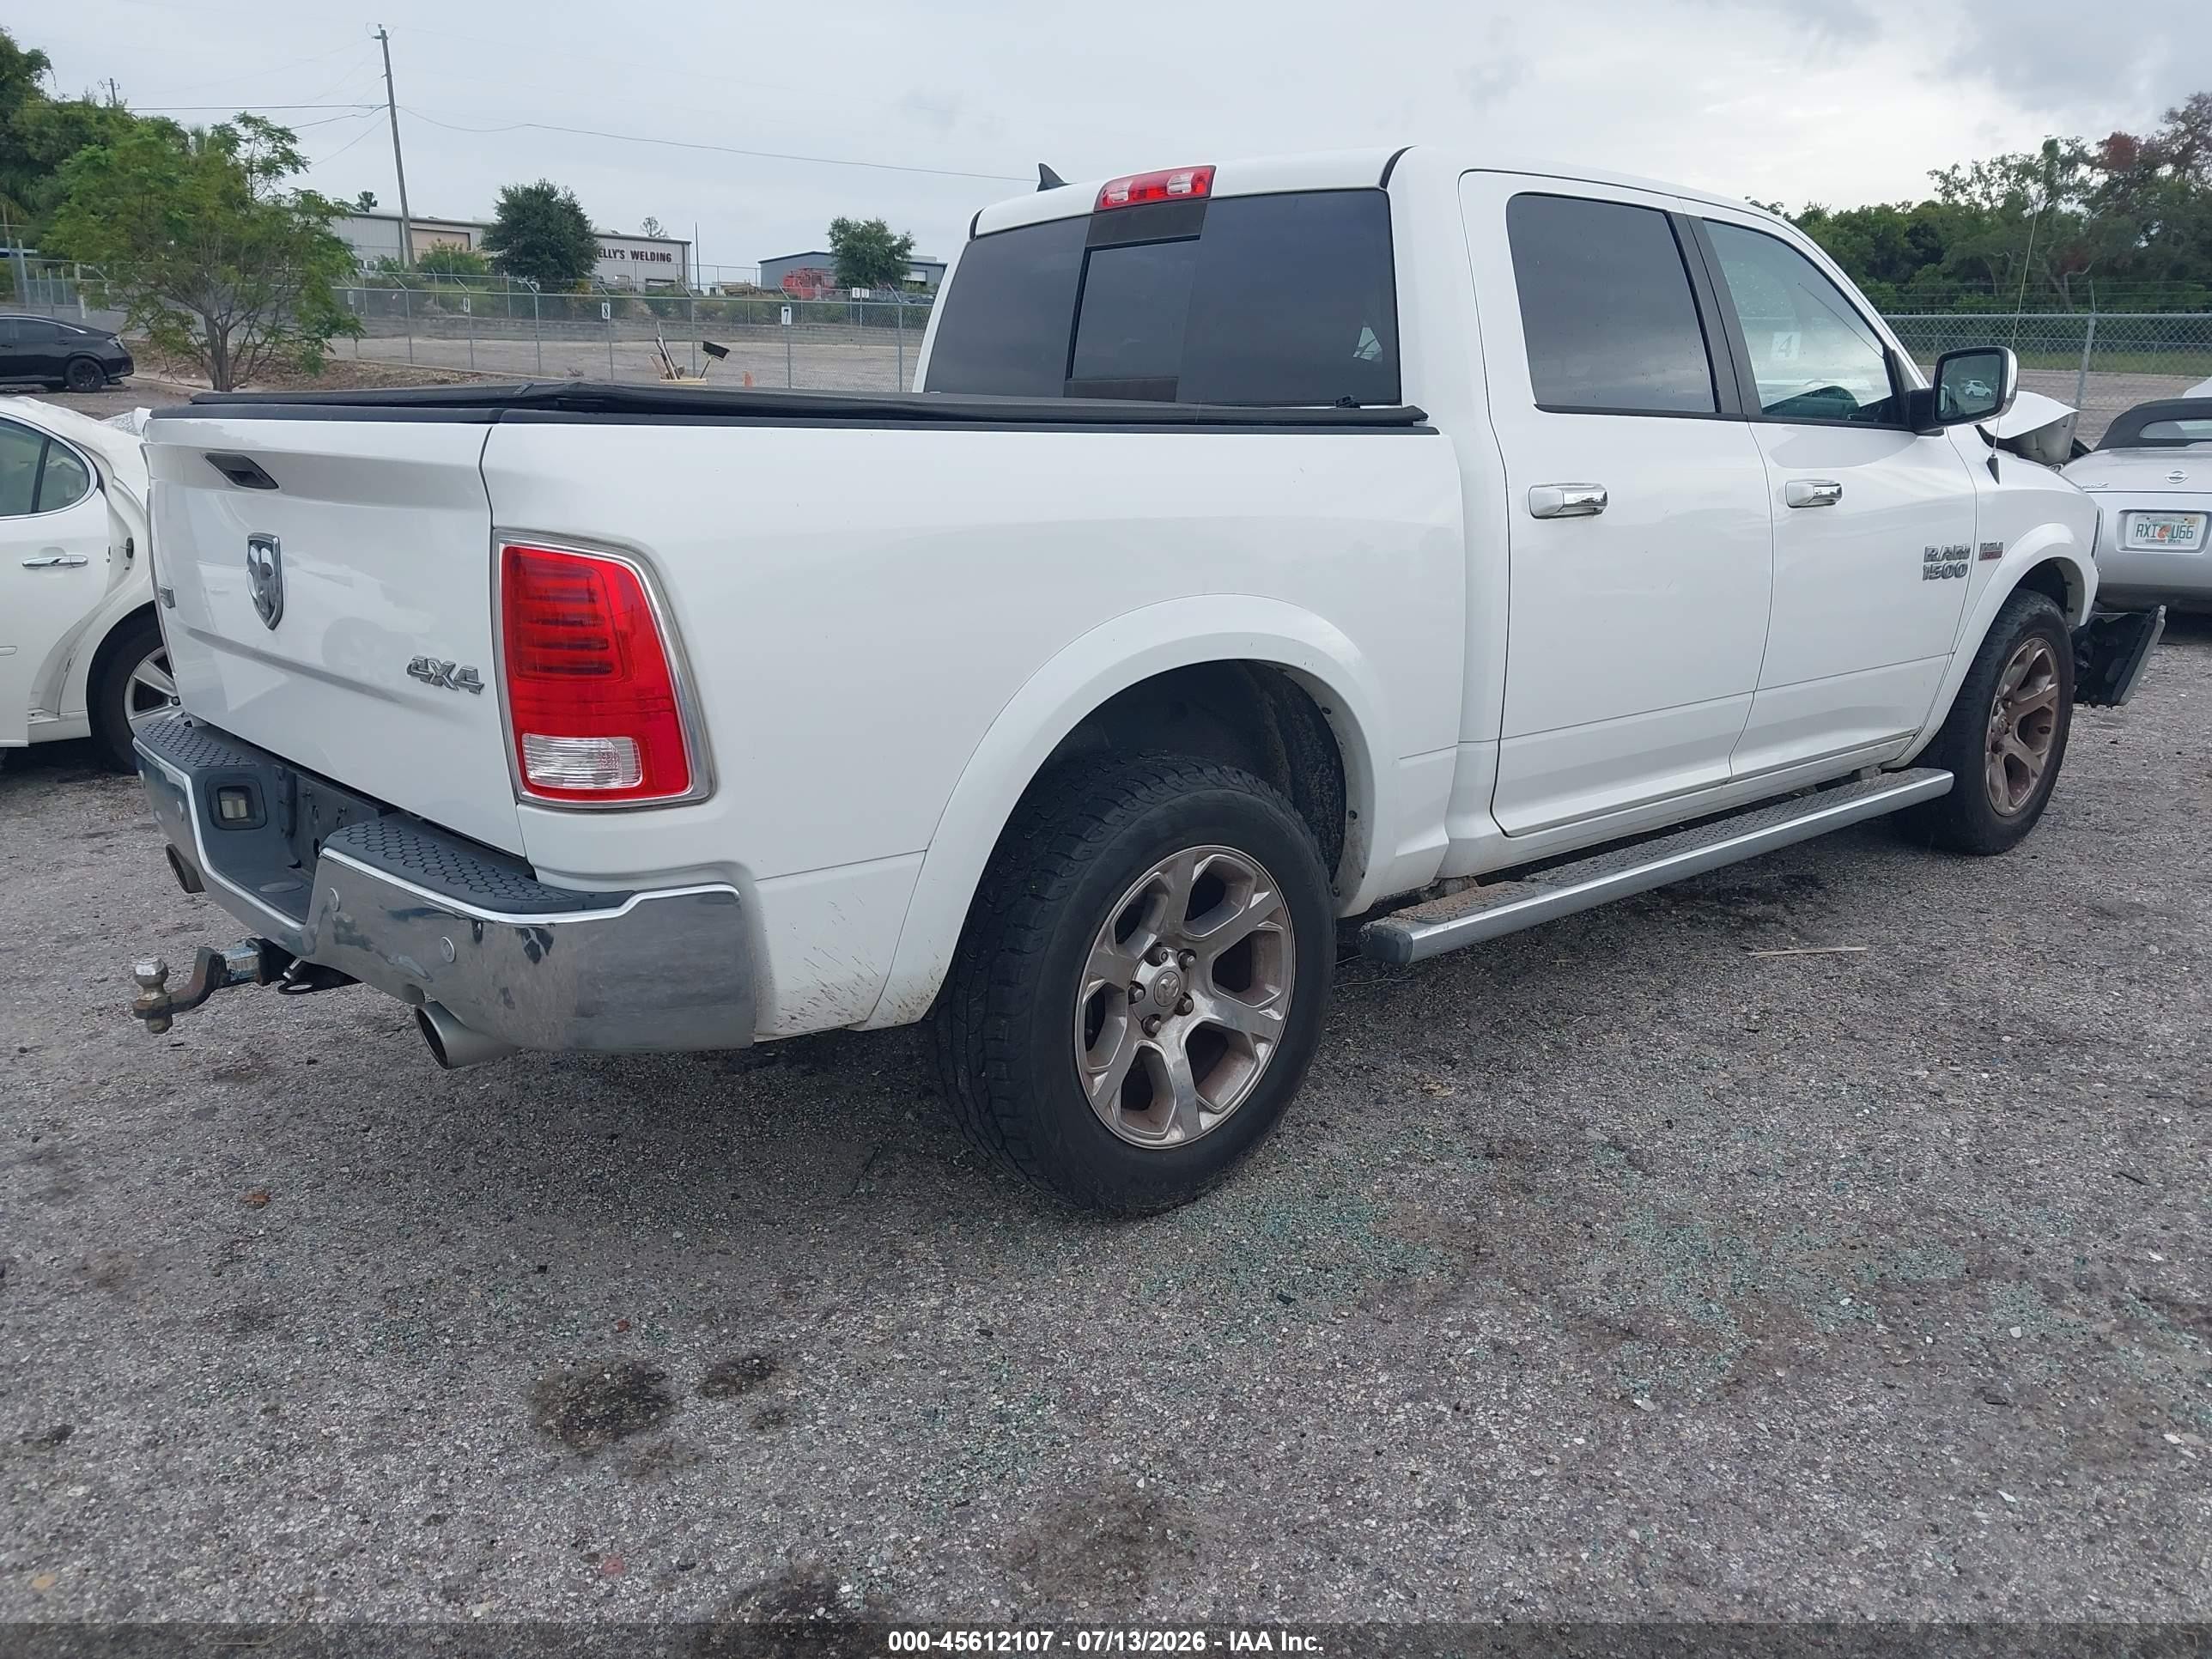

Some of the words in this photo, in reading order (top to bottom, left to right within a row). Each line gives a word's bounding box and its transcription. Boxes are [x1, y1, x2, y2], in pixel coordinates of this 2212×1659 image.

[595, 247, 626, 260] ELLY'S
[630, 249, 672, 263] WELDING
[783, 308, 789, 324] 7
[2136, 523, 2160, 538] RXI
[2171, 525, 2195, 539] U66
[1923, 544, 1971, 562] RAM
[1923, 561, 1969, 581] 1500
